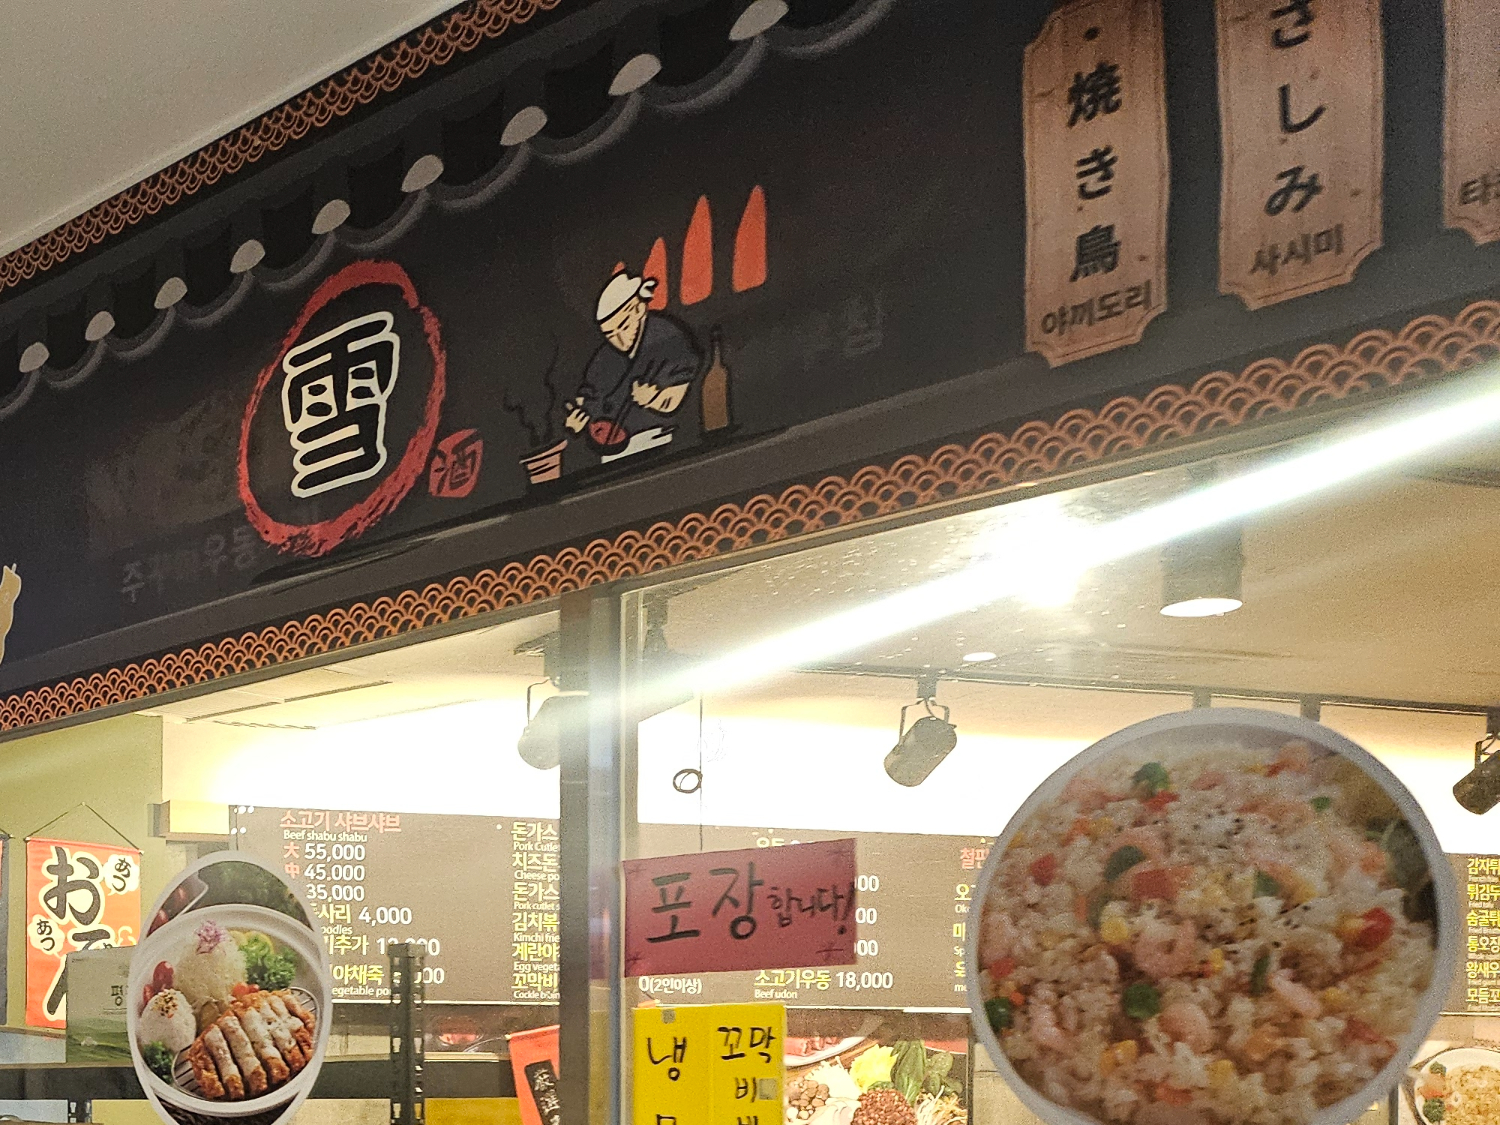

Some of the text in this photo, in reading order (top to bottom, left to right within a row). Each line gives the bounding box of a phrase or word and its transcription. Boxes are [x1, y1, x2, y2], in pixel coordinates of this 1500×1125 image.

[1249, 223, 1345, 277] 사시미
[1041, 280, 1153, 336] 야끼도리
[281, 311, 401, 499] 雪
[279, 809, 402, 834] 소고기 샤브샤브
[510, 821, 560, 842] 돈가스
[283, 829, 368, 843] Beef shabu shabu
[513, 841, 534, 851] Pork
[283, 841, 366, 862] 大 55,000
[511, 851, 560, 873] 치즈돈
[284, 862, 300, 879] 中
[514, 869, 547, 880] Cheese
[305, 883, 365, 902] 35,000
[511, 881, 560, 902] 돈가스
[310, 903, 412, 926] 사리 4,000
[513, 932, 544, 943] Kimchi
[511, 941, 560, 962] 계란야
[330, 963, 384, 985] 야채죽
[513, 961, 532, 973] Egg
[754, 969, 894, 991] 소고기우동 18,000
[754, 988, 798, 999] Beef udon
